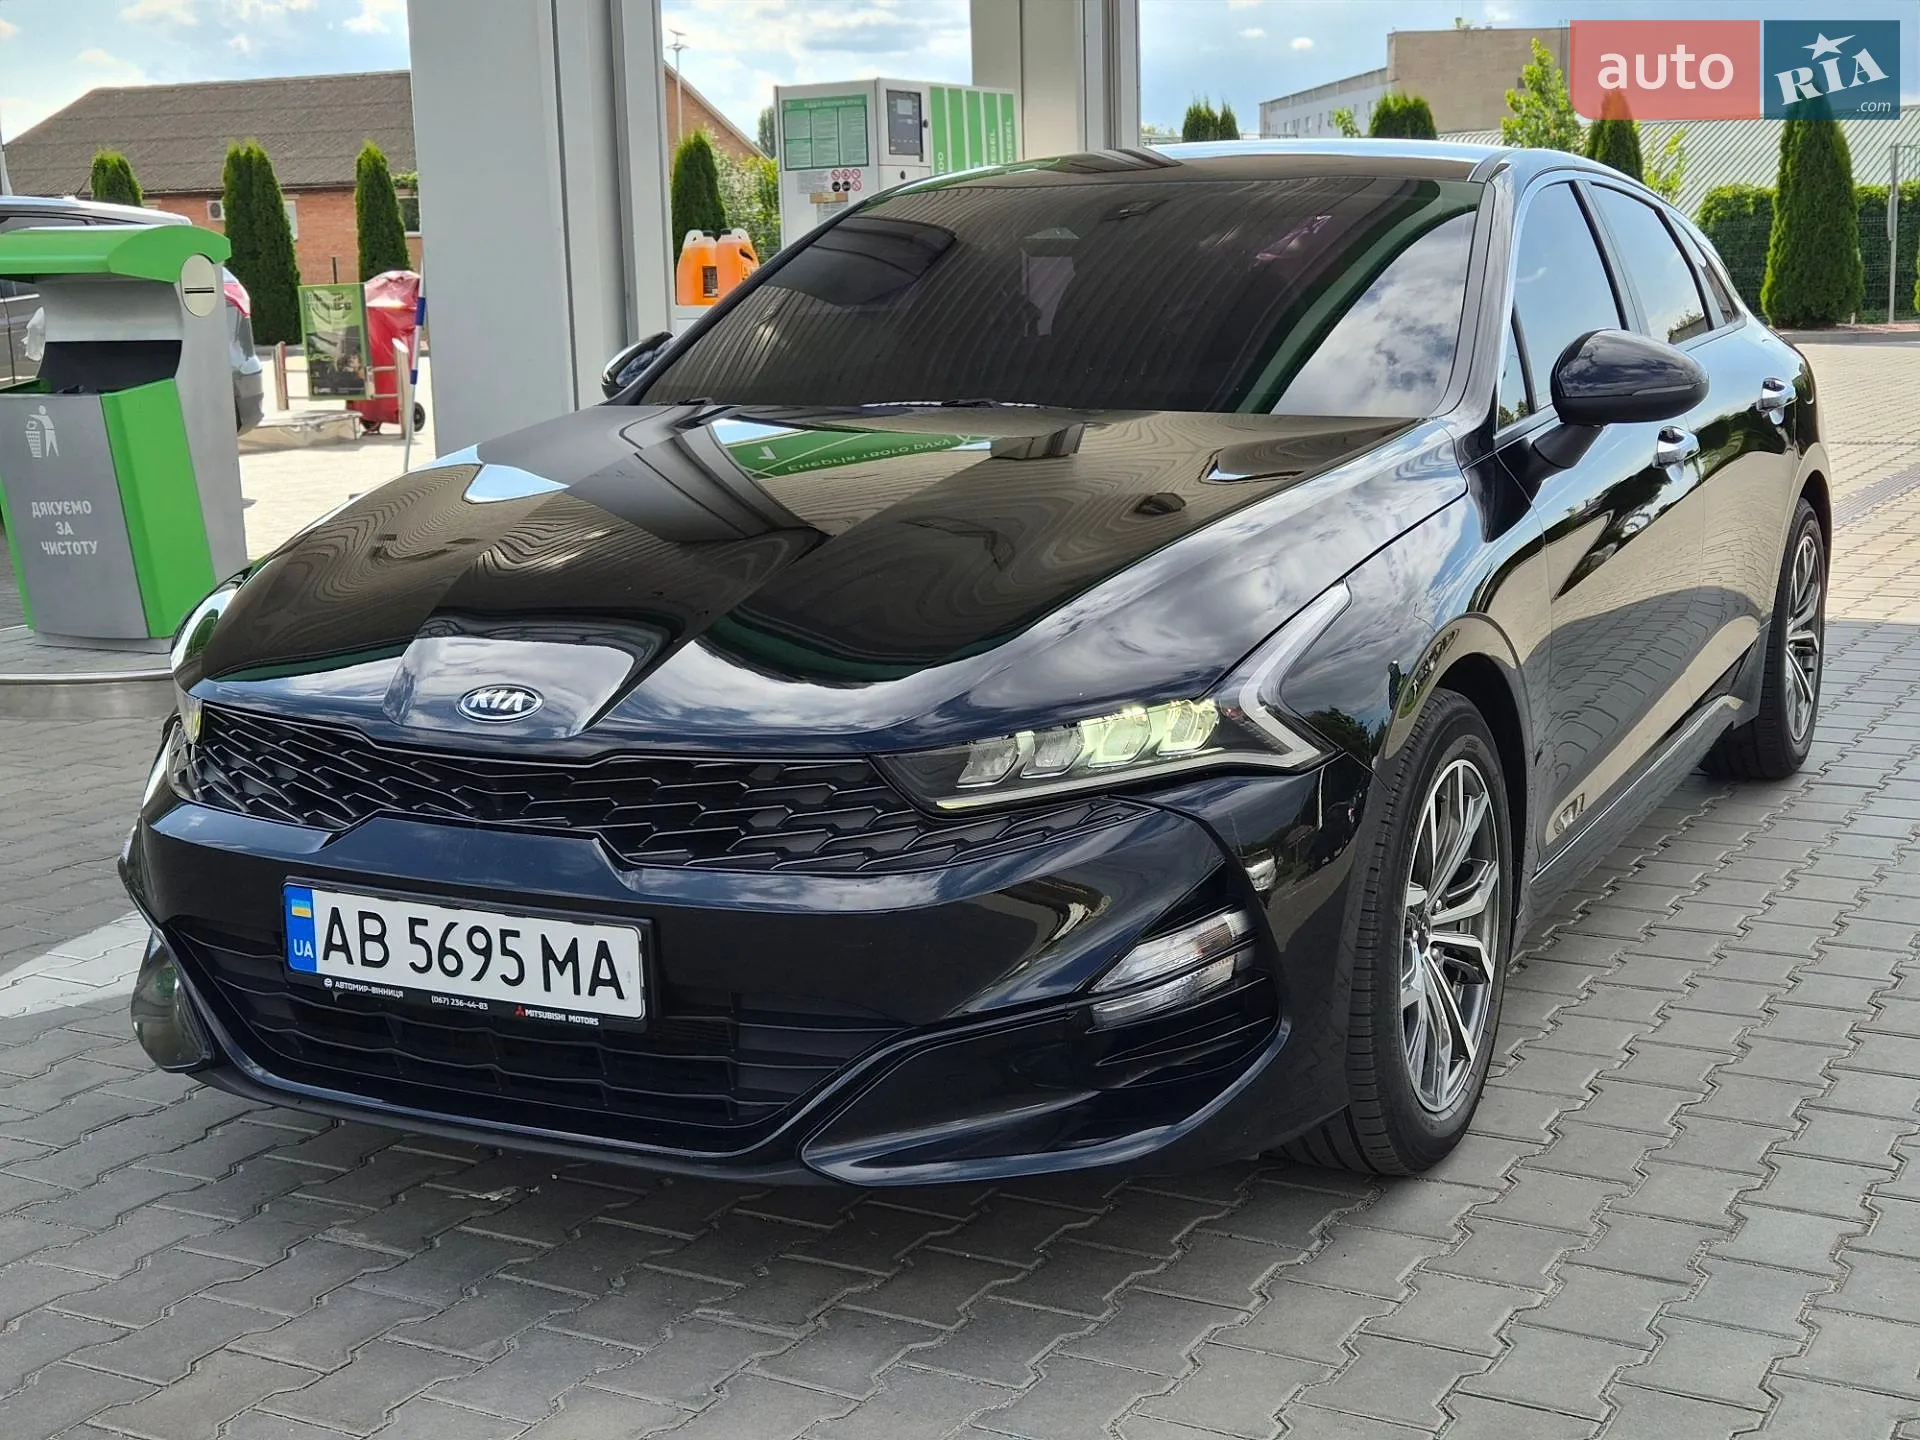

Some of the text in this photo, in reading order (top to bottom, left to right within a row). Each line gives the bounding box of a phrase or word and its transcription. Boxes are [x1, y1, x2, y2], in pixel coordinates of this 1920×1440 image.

[31, 500, 92, 518] ДЯКУЄМО
[55, 521, 74, 535] ЗА
[40, 540, 98, 556] ЧИСТОТУ
[469, 689, 526, 712] KIA
[294, 939, 314, 959] UA
[322, 906, 625, 1000] AB 5695 MA
[431, 995, 450, 1006] (067)
[525, 1009, 599, 1026] MITSUBISHI MOTORS
